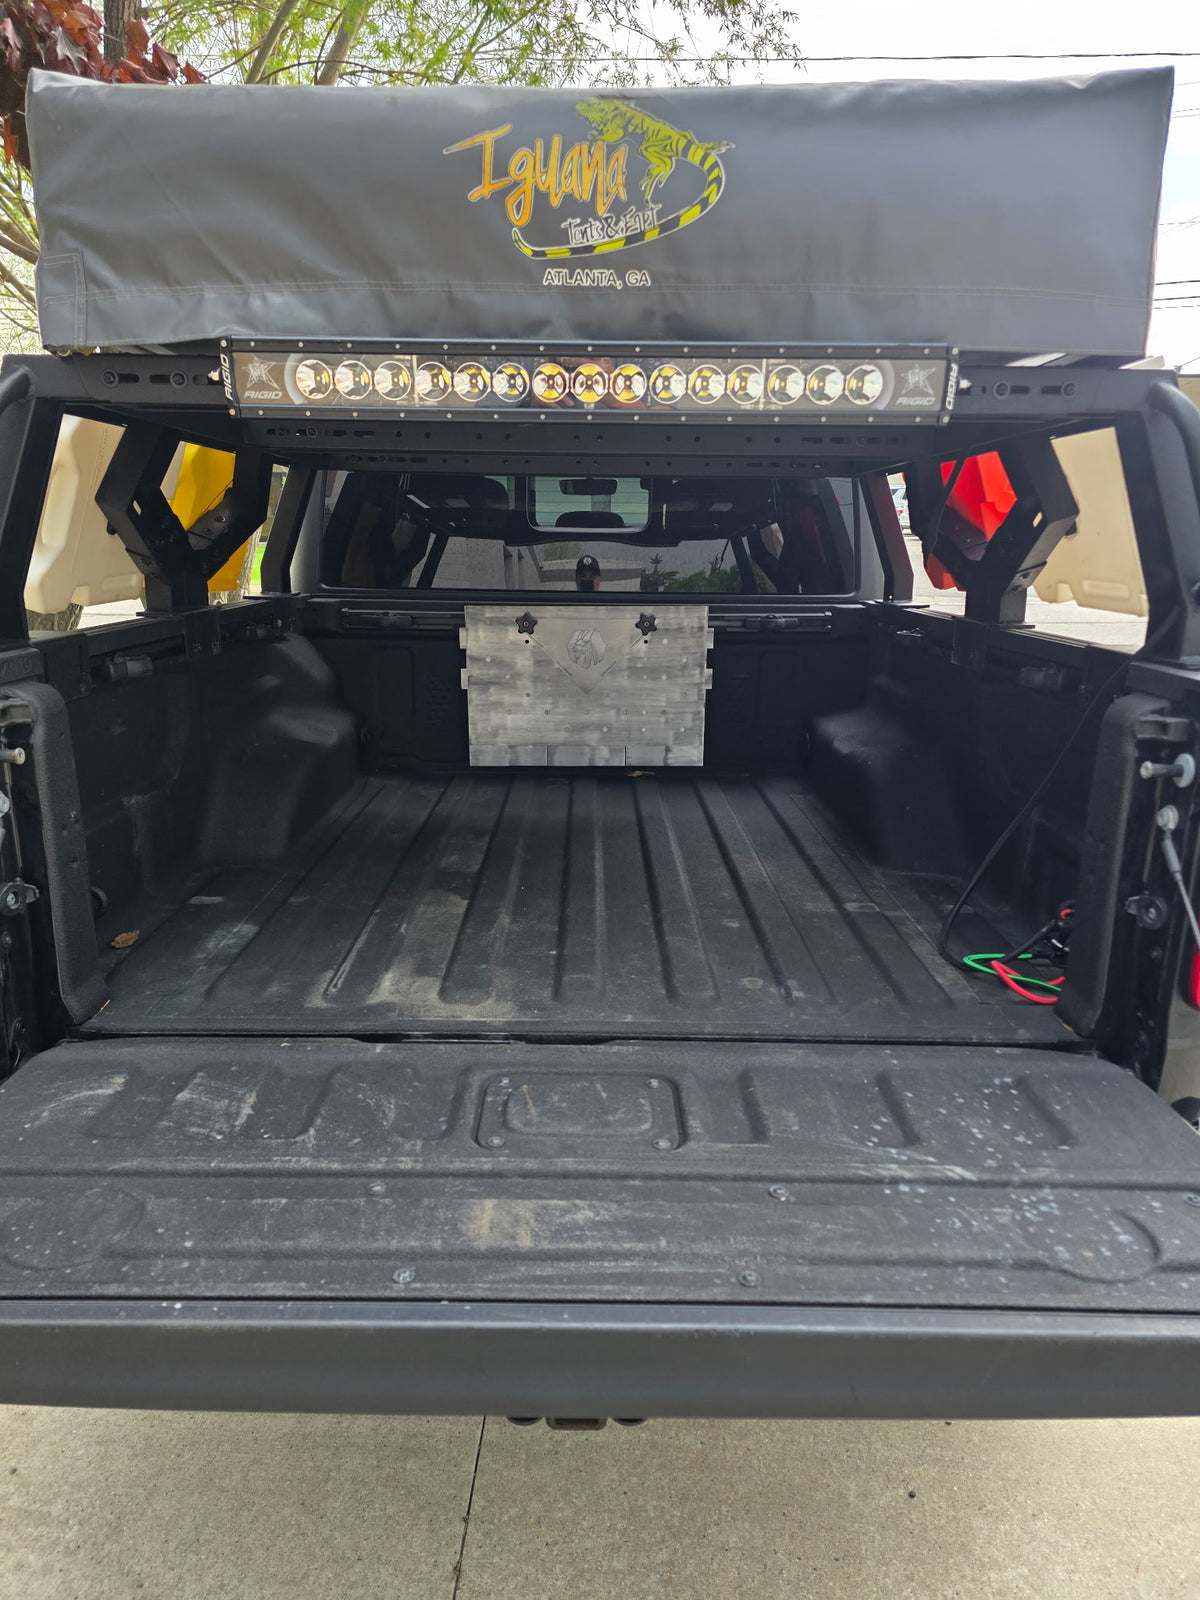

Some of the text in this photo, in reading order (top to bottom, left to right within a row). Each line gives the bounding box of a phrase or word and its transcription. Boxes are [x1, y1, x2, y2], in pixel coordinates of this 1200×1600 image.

[443, 123, 628, 227] Iguana
[543, 268, 651, 290] ATLANTA, GA
[220, 353, 234, 401] RIGID
[944, 362, 959, 410] RIGID
[243, 390, 283, 400] RIGID
[895, 396, 936, 406] RIGID
